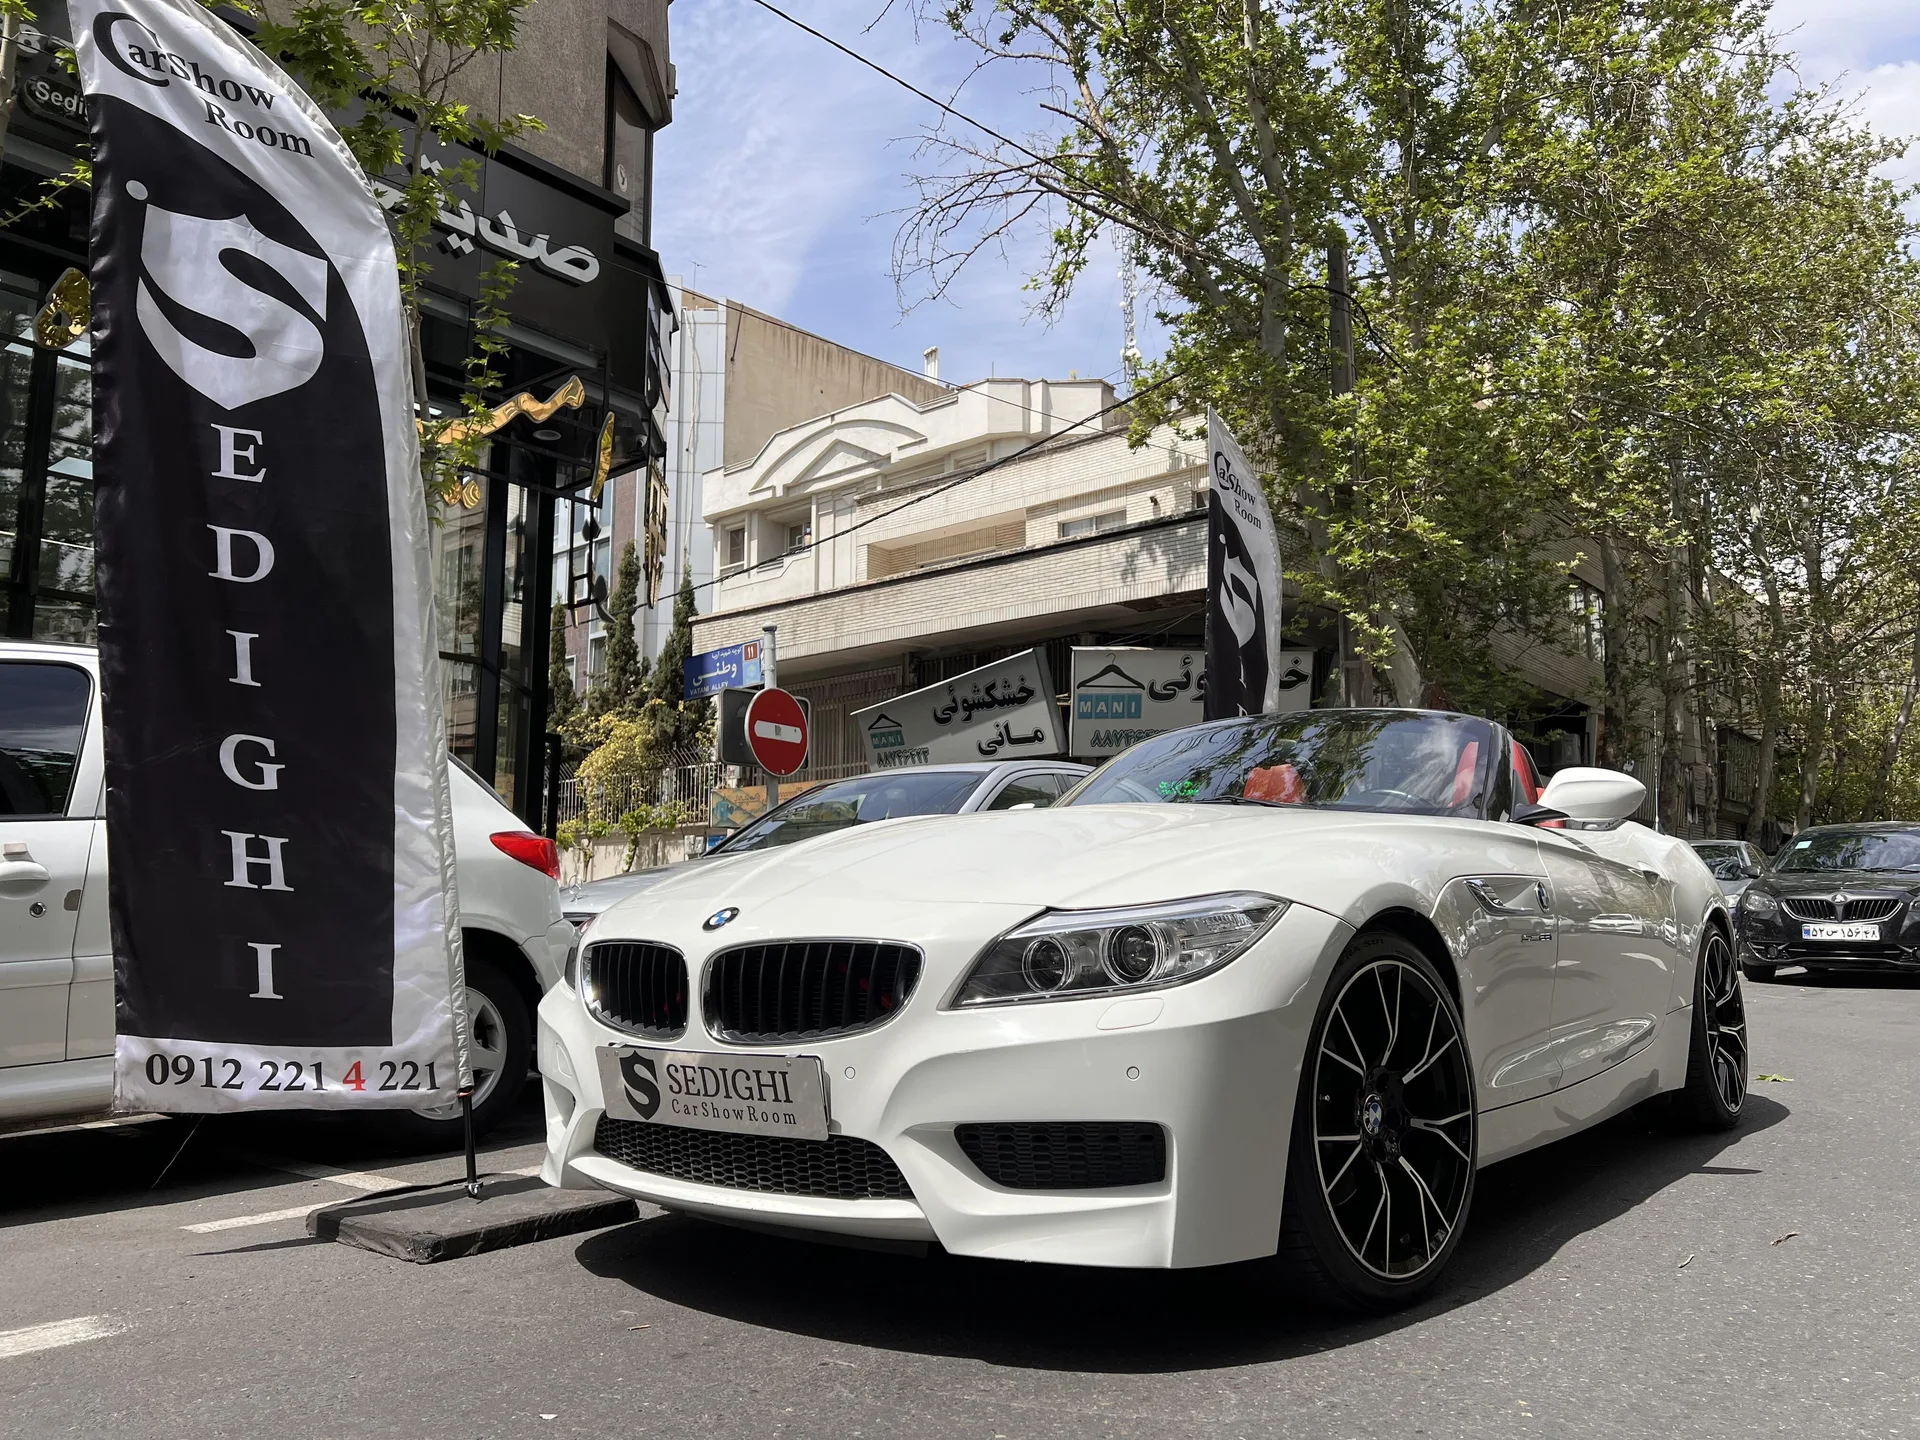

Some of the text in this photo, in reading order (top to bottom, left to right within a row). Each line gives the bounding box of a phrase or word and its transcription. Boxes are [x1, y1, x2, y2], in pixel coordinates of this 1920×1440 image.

[35, 81, 87, 117] Sedi
[199, 95, 316, 159] Room
[1234, 498, 1262, 530] Room
[747, 645, 754, 659] ۱۱
[692, 661, 738, 687] وطنی
[711, 681, 729, 691] ALLEY
[1079, 701, 1136, 714] MANI
[872, 734, 902, 746] MANI
[977, 720, 1045, 756] مانی
[145, 1053, 440, 1092] 0912 221 4 221
[666, 1064, 794, 1104] SEDIGHI
[671, 1098, 797, 1125] CarShowRoom
